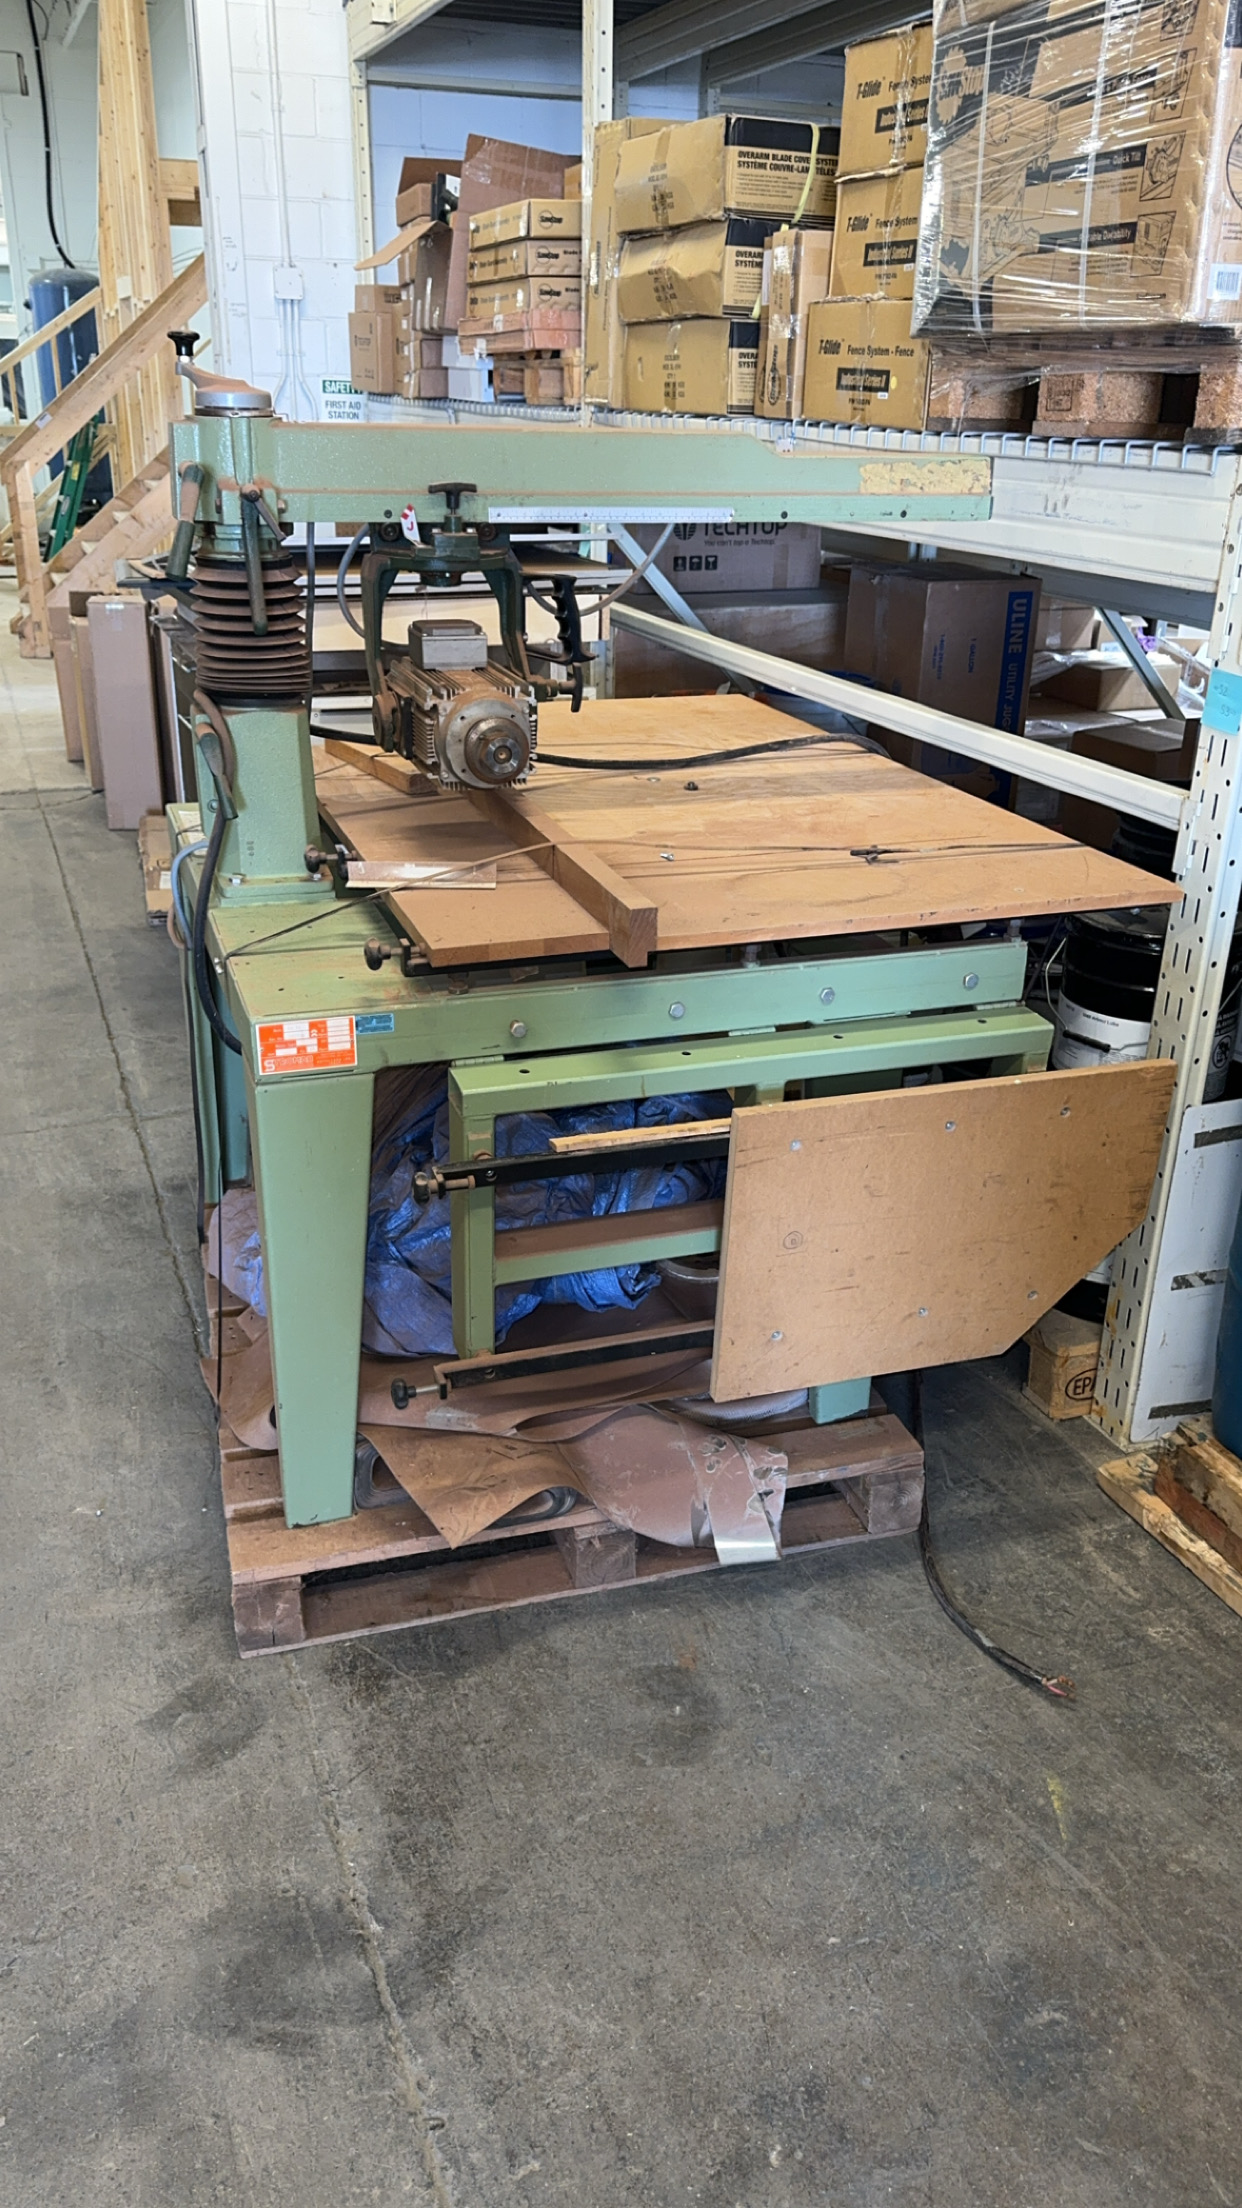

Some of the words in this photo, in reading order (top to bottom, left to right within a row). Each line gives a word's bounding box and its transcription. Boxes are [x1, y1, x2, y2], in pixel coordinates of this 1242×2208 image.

[738, 150, 770, 161] OVERARM
[772, 153, 792, 163] BLADE
[794, 156, 812, 165] COVE
[895, 216, 918, 229] System
[818, 339, 842, 355] T-Glide
[847, 345, 866, 355] Fence
[867, 345, 890, 358] System
[895, 346, 914, 357] Fence
[325, 400, 346, 409] FIRST
[349, 401, 362, 410] AID
[328, 411, 359, 420] STATION
[1008, 598, 1027, 654] ULINE
[968, 644, 976, 673] GALLON
[1003, 663, 1018, 701] UTILITY
[1001, 704, 1013, 731] JUG
